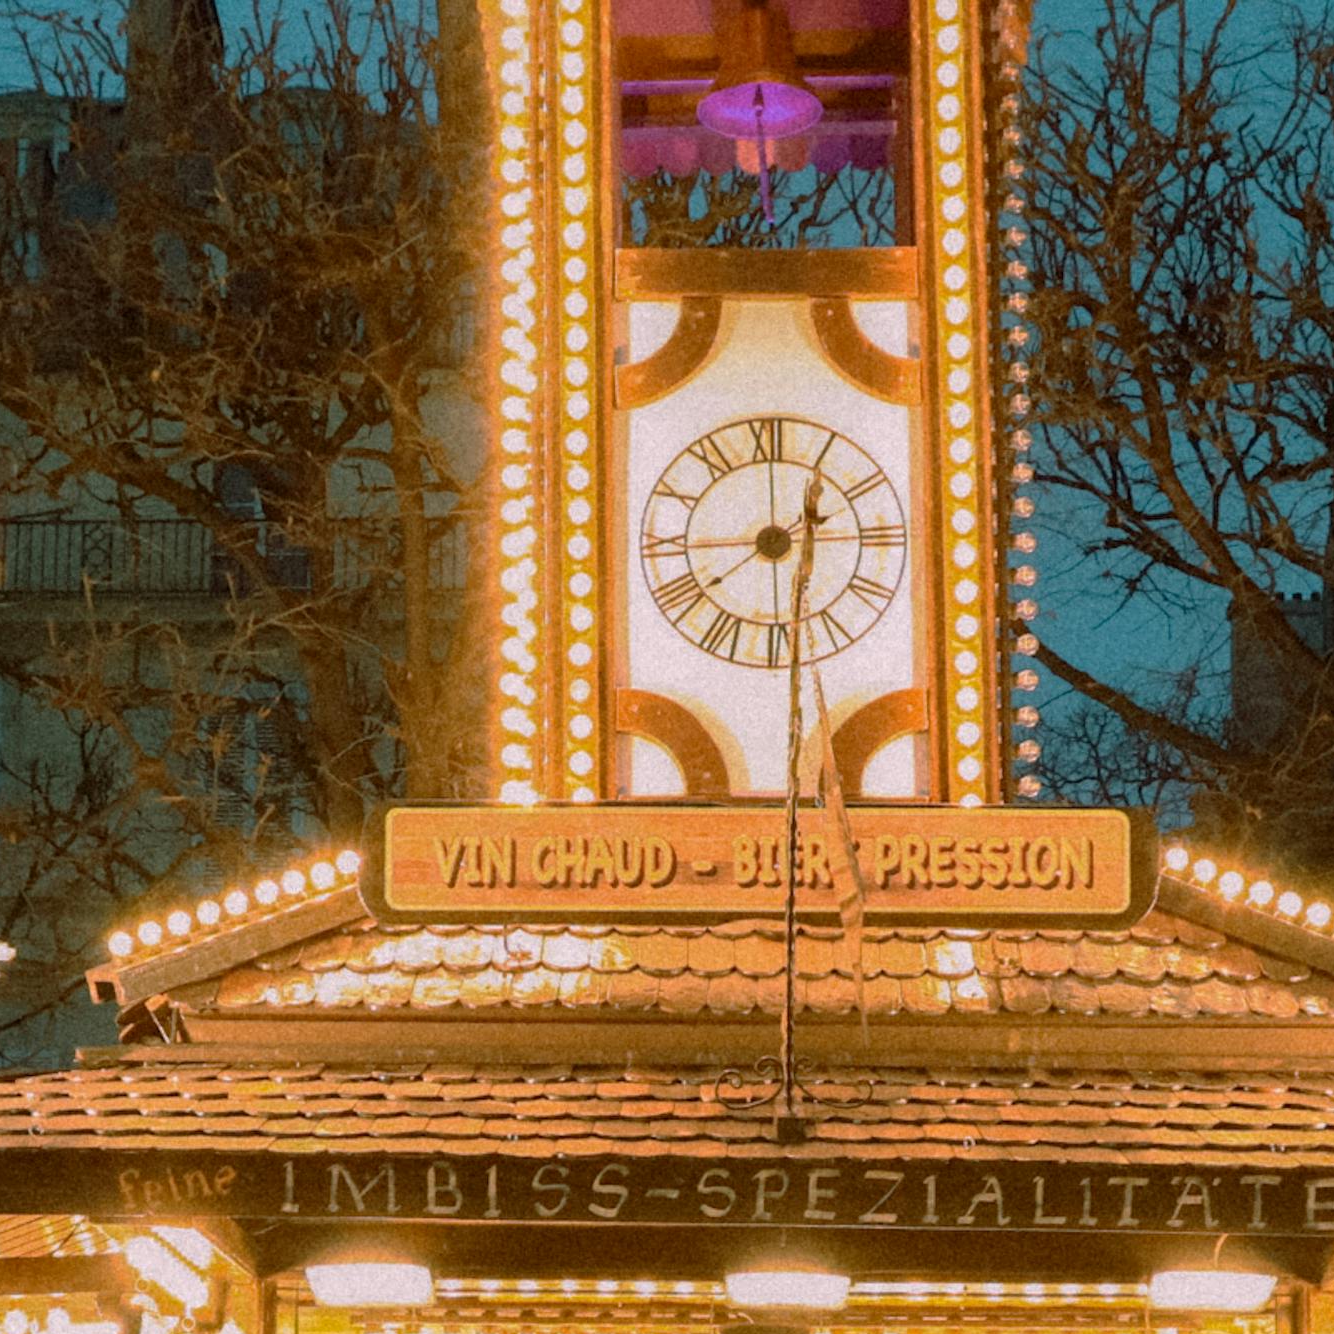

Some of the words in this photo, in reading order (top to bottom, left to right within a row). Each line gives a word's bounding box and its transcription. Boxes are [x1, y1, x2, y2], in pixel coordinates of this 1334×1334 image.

[433, 834, 515, 888] VIN
[531, 834, 677, 888] CHAUD
[732, 833, 859, 890] BIER
[875, 834, 1094, 891] PRESSION
